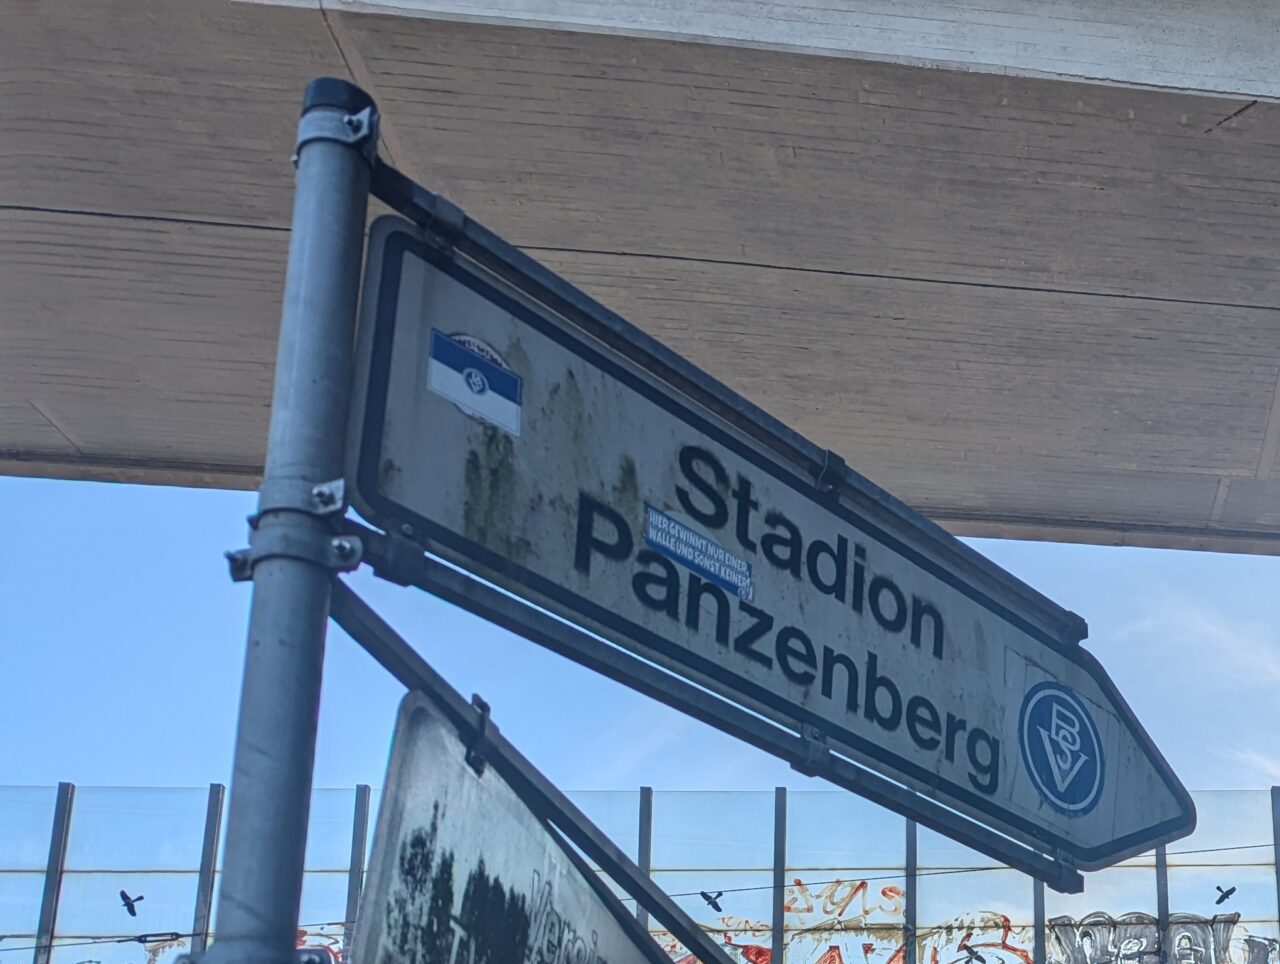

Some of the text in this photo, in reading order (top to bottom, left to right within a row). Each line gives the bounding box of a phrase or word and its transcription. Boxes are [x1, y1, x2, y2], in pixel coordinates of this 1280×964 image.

[648, 509, 669, 532] HIER
[669, 521, 706, 552] GEWINNT
[707, 543, 725, 561] NUR
[648, 525, 676, 550] WALLE
[676, 543, 695, 562] UND
[694, 552, 719, 576] SONST
[675, 446, 945, 661] Stadion
[573, 491, 1001, 796] Panzenberg
